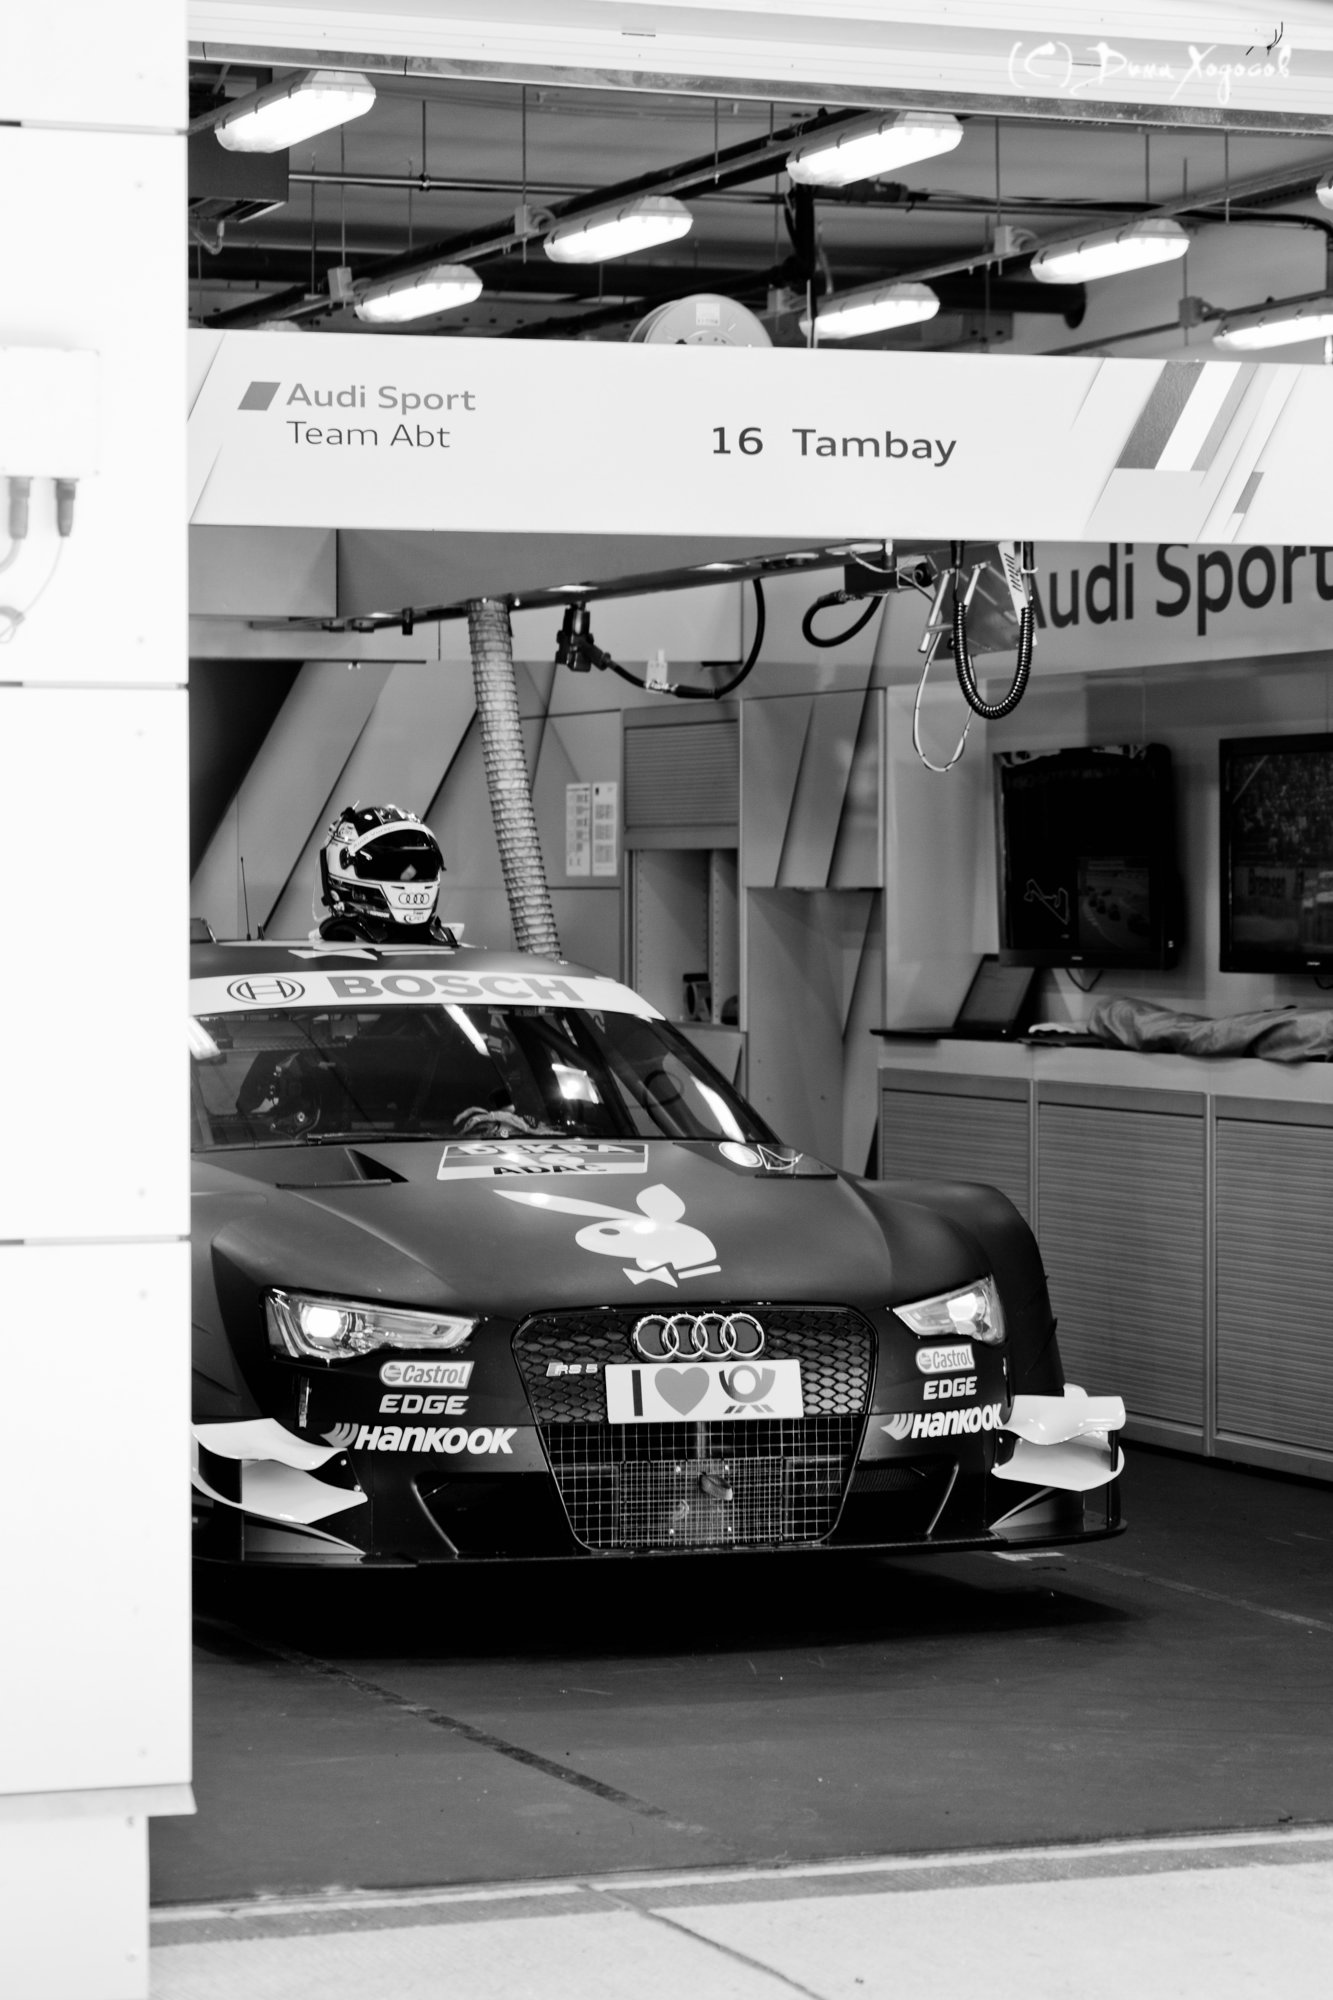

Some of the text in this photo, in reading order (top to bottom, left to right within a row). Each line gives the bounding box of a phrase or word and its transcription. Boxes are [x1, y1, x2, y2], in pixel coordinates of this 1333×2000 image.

[286, 383, 477, 416] Audi Sport
[286, 420, 451, 448] Team Abt
[713, 427, 957, 467] 16 Tambay
[1156, 543, 1333, 636] Sport
[326, 975, 585, 1001] BOSCH
[493, 1165, 607, 1175] ADAC
[933, 1348, 973, 1370] Castrol
[402, 1364, 467, 1385] Castrol
[923, 1376, 978, 1401] EDGE
[378, 1394, 470, 1416] EDGE
